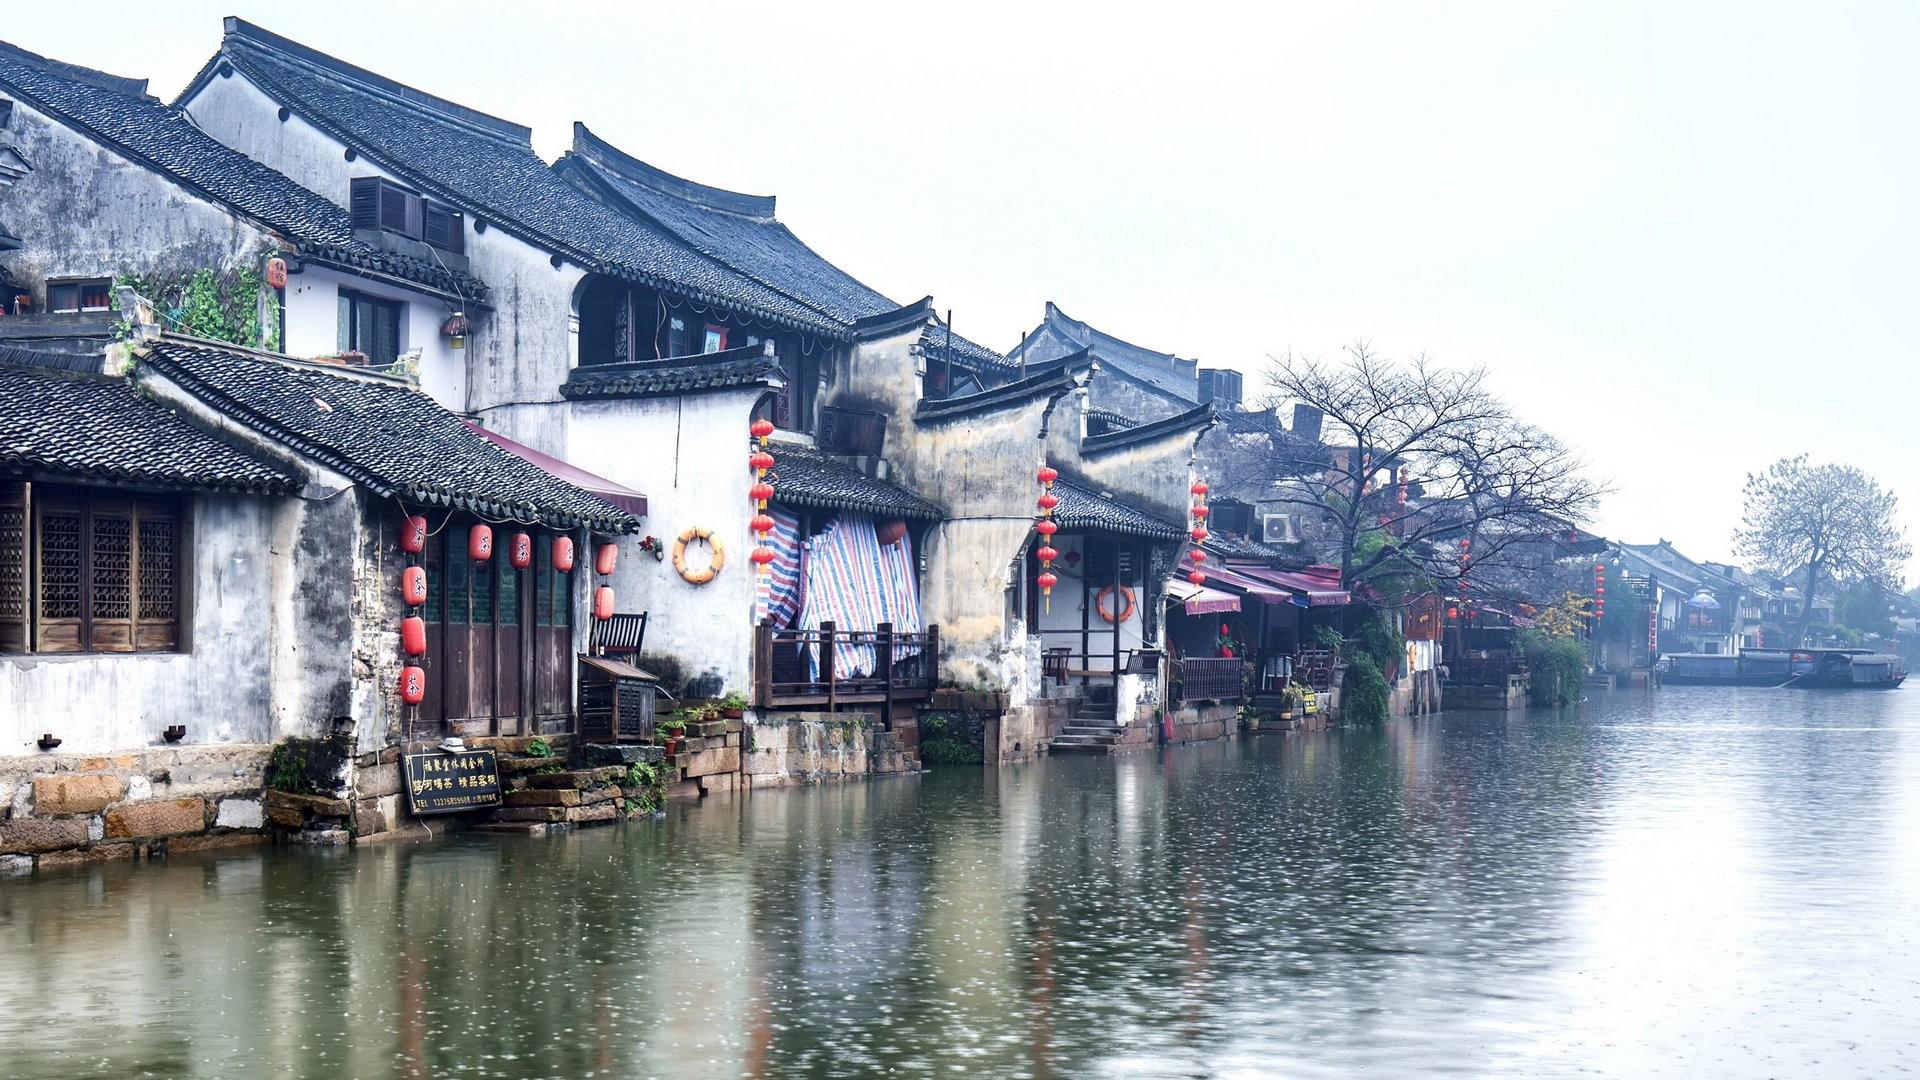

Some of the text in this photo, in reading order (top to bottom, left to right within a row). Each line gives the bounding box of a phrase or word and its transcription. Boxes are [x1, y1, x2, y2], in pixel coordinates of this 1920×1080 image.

[480, 535, 490, 552] 茶
[519, 543, 528, 560] 茶
[415, 575, 425, 595] 茶
[407, 674, 420, 696] 茶
[458, 774, 497, 788] 精品客栈
[416, 799, 429, 808] TEL
